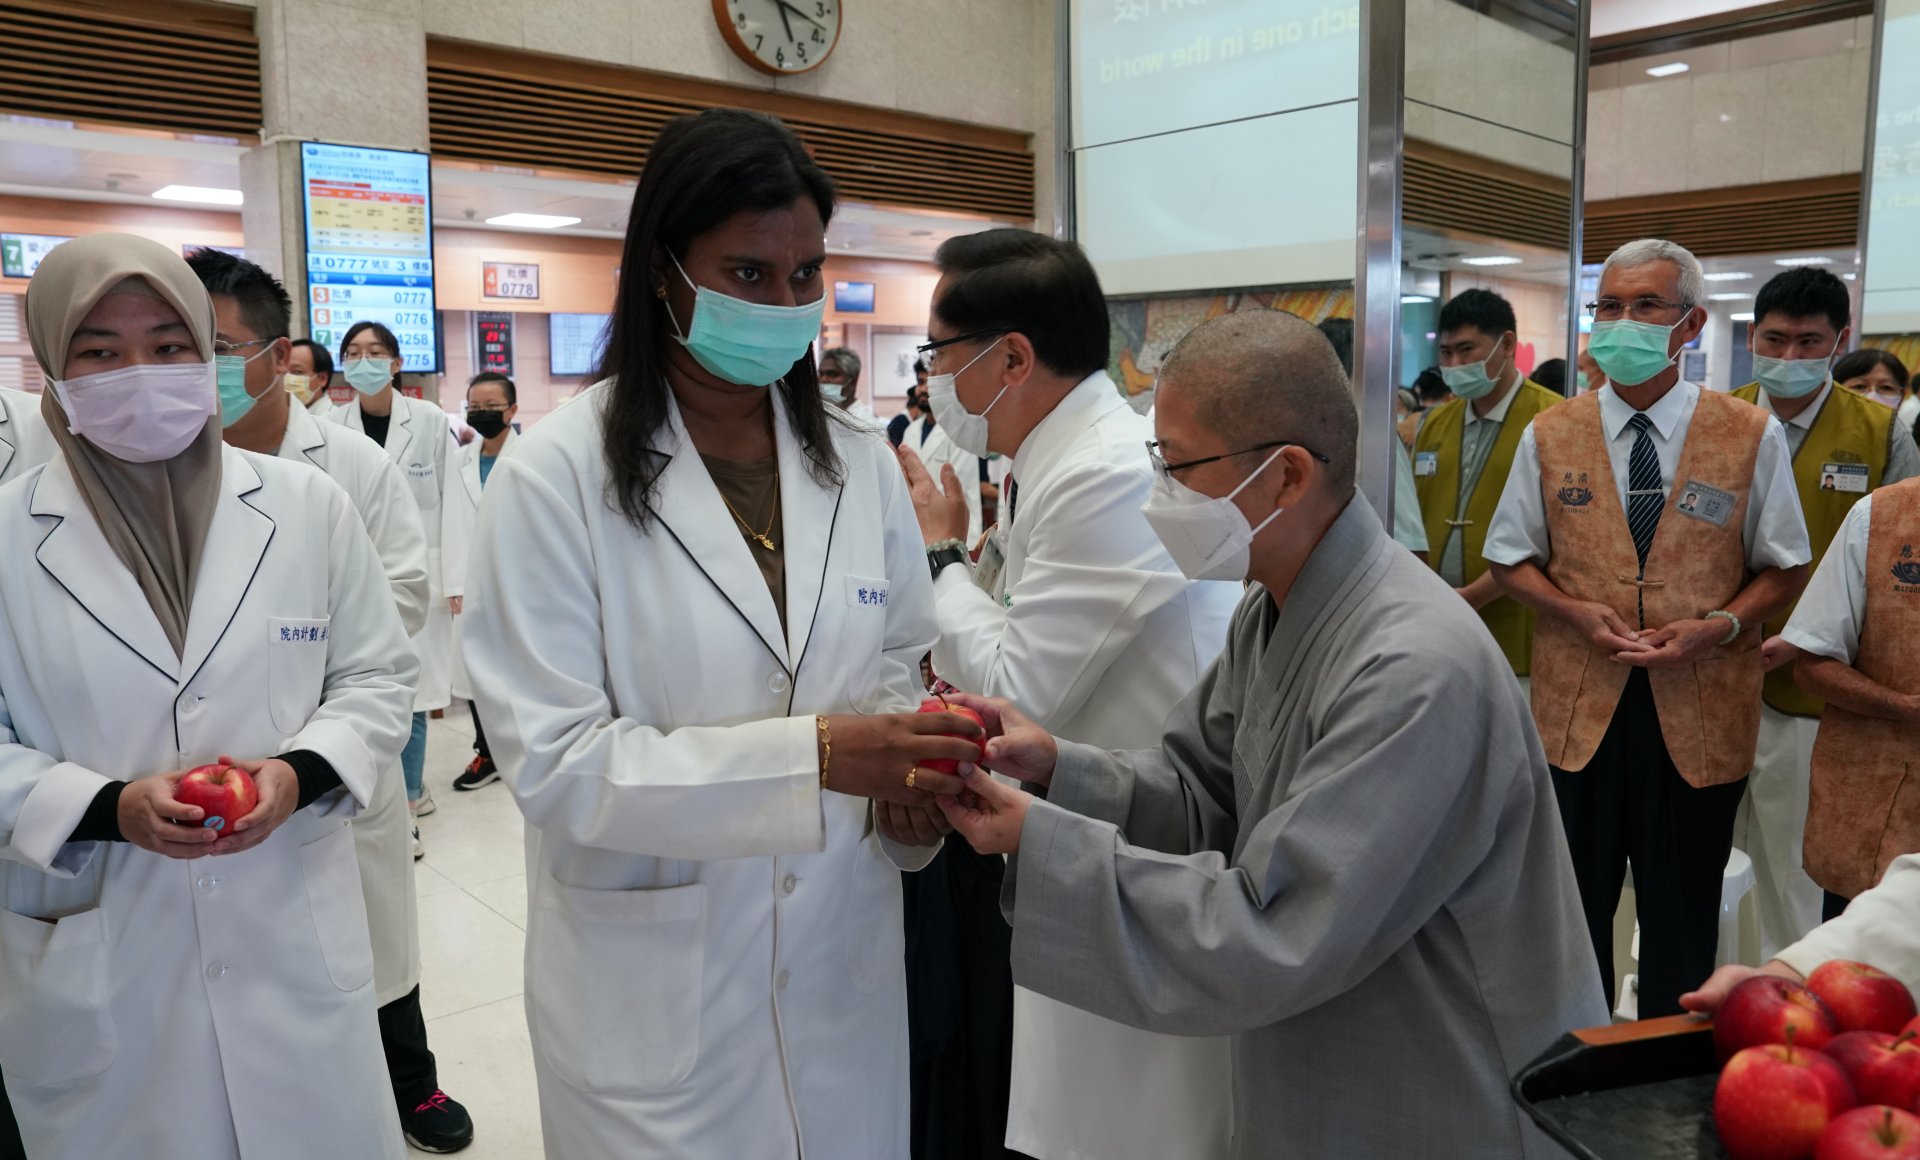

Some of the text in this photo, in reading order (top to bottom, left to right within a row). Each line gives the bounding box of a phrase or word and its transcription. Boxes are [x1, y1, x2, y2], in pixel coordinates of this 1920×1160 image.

[816, 2, 825, 18] 3
[738, 13, 746, 29] 8
[755, 34, 764, 50] 7
[811, 28, 820, 43] 4
[776, 47, 784, 62] 6
[797, 42, 805, 58] 5
[6, 245, 19, 261] 7
[325, 257, 368, 270] 0777
[396, 261, 406, 272] 3
[316, 288, 327, 301] 3
[394, 292, 426, 303] 0777
[501, 283, 534, 296] 0778
[317, 310, 327, 322] 6
[395, 313, 428, 325] 0776
[318, 331, 328, 345] 7
[398, 333, 429, 346] 4258
[405, 354, 430, 366] 775
[858, 587, 889, 607] 院內計
